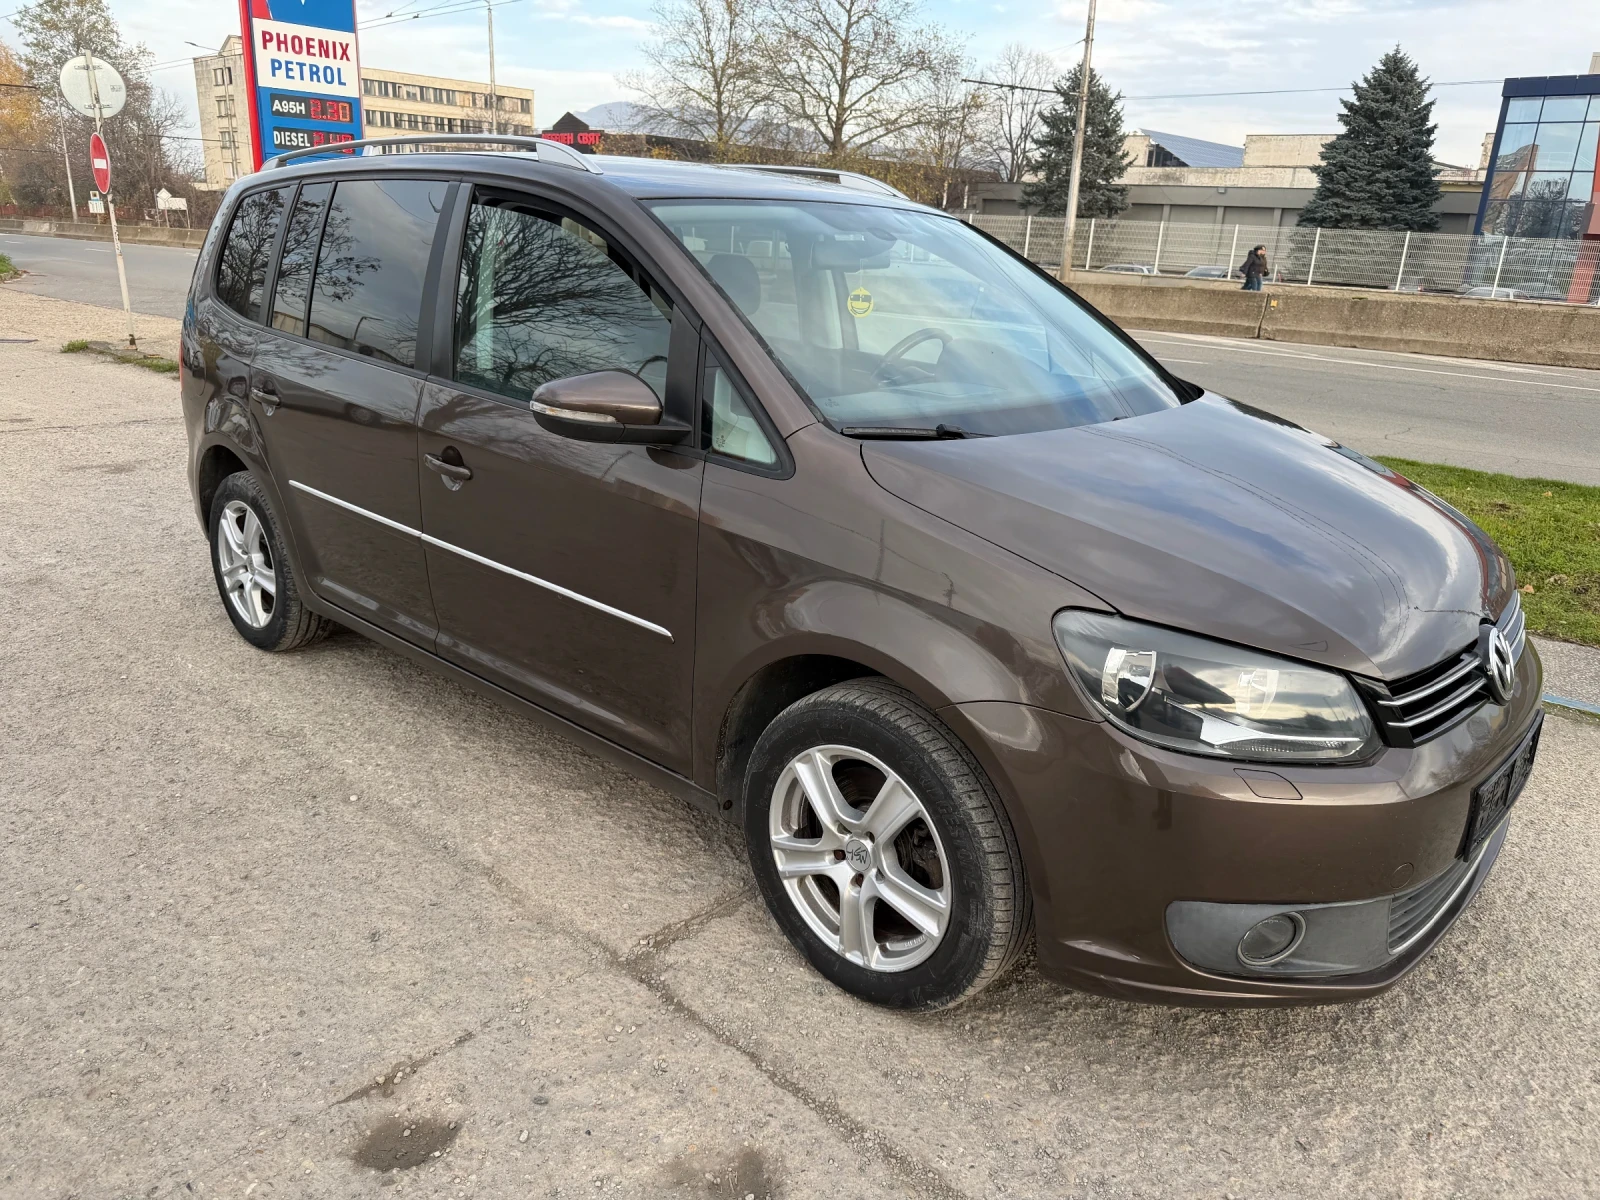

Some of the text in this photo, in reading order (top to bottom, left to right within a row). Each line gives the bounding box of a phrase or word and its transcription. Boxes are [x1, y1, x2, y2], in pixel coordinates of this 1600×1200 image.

[261, 30, 351, 62] PHOENIX
[270, 58, 347, 86] PETROL
[272, 99, 350, 122] A95H 2.30
[273, 130, 311, 147] DIESEL
